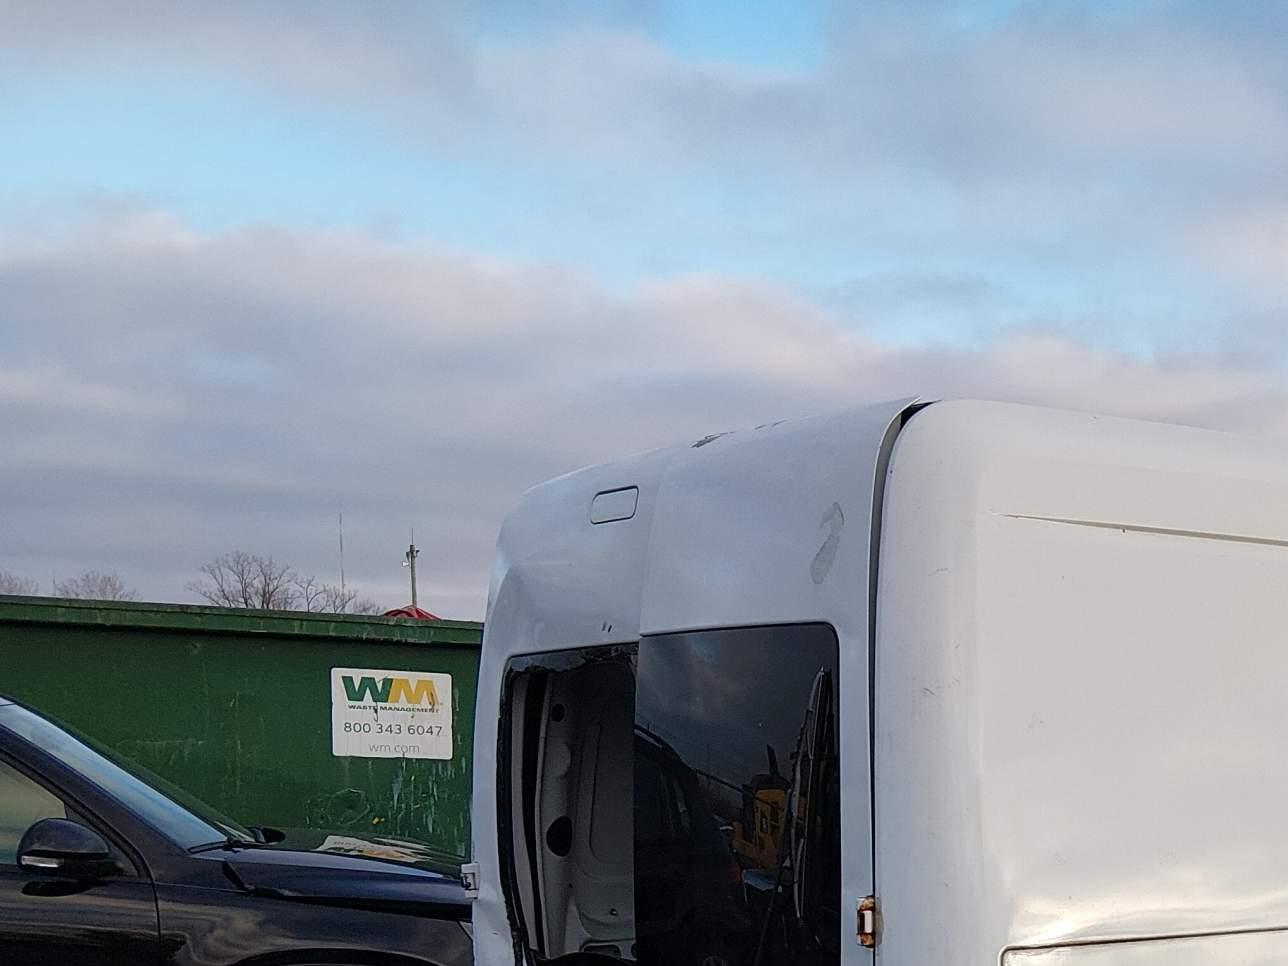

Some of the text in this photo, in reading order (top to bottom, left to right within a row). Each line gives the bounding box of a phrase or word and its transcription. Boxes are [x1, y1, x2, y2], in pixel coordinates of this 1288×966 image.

[342, 676, 439, 705] WM
[343, 722, 443, 737] 800 343 6047
[368, 743, 420, 754] wm.com
